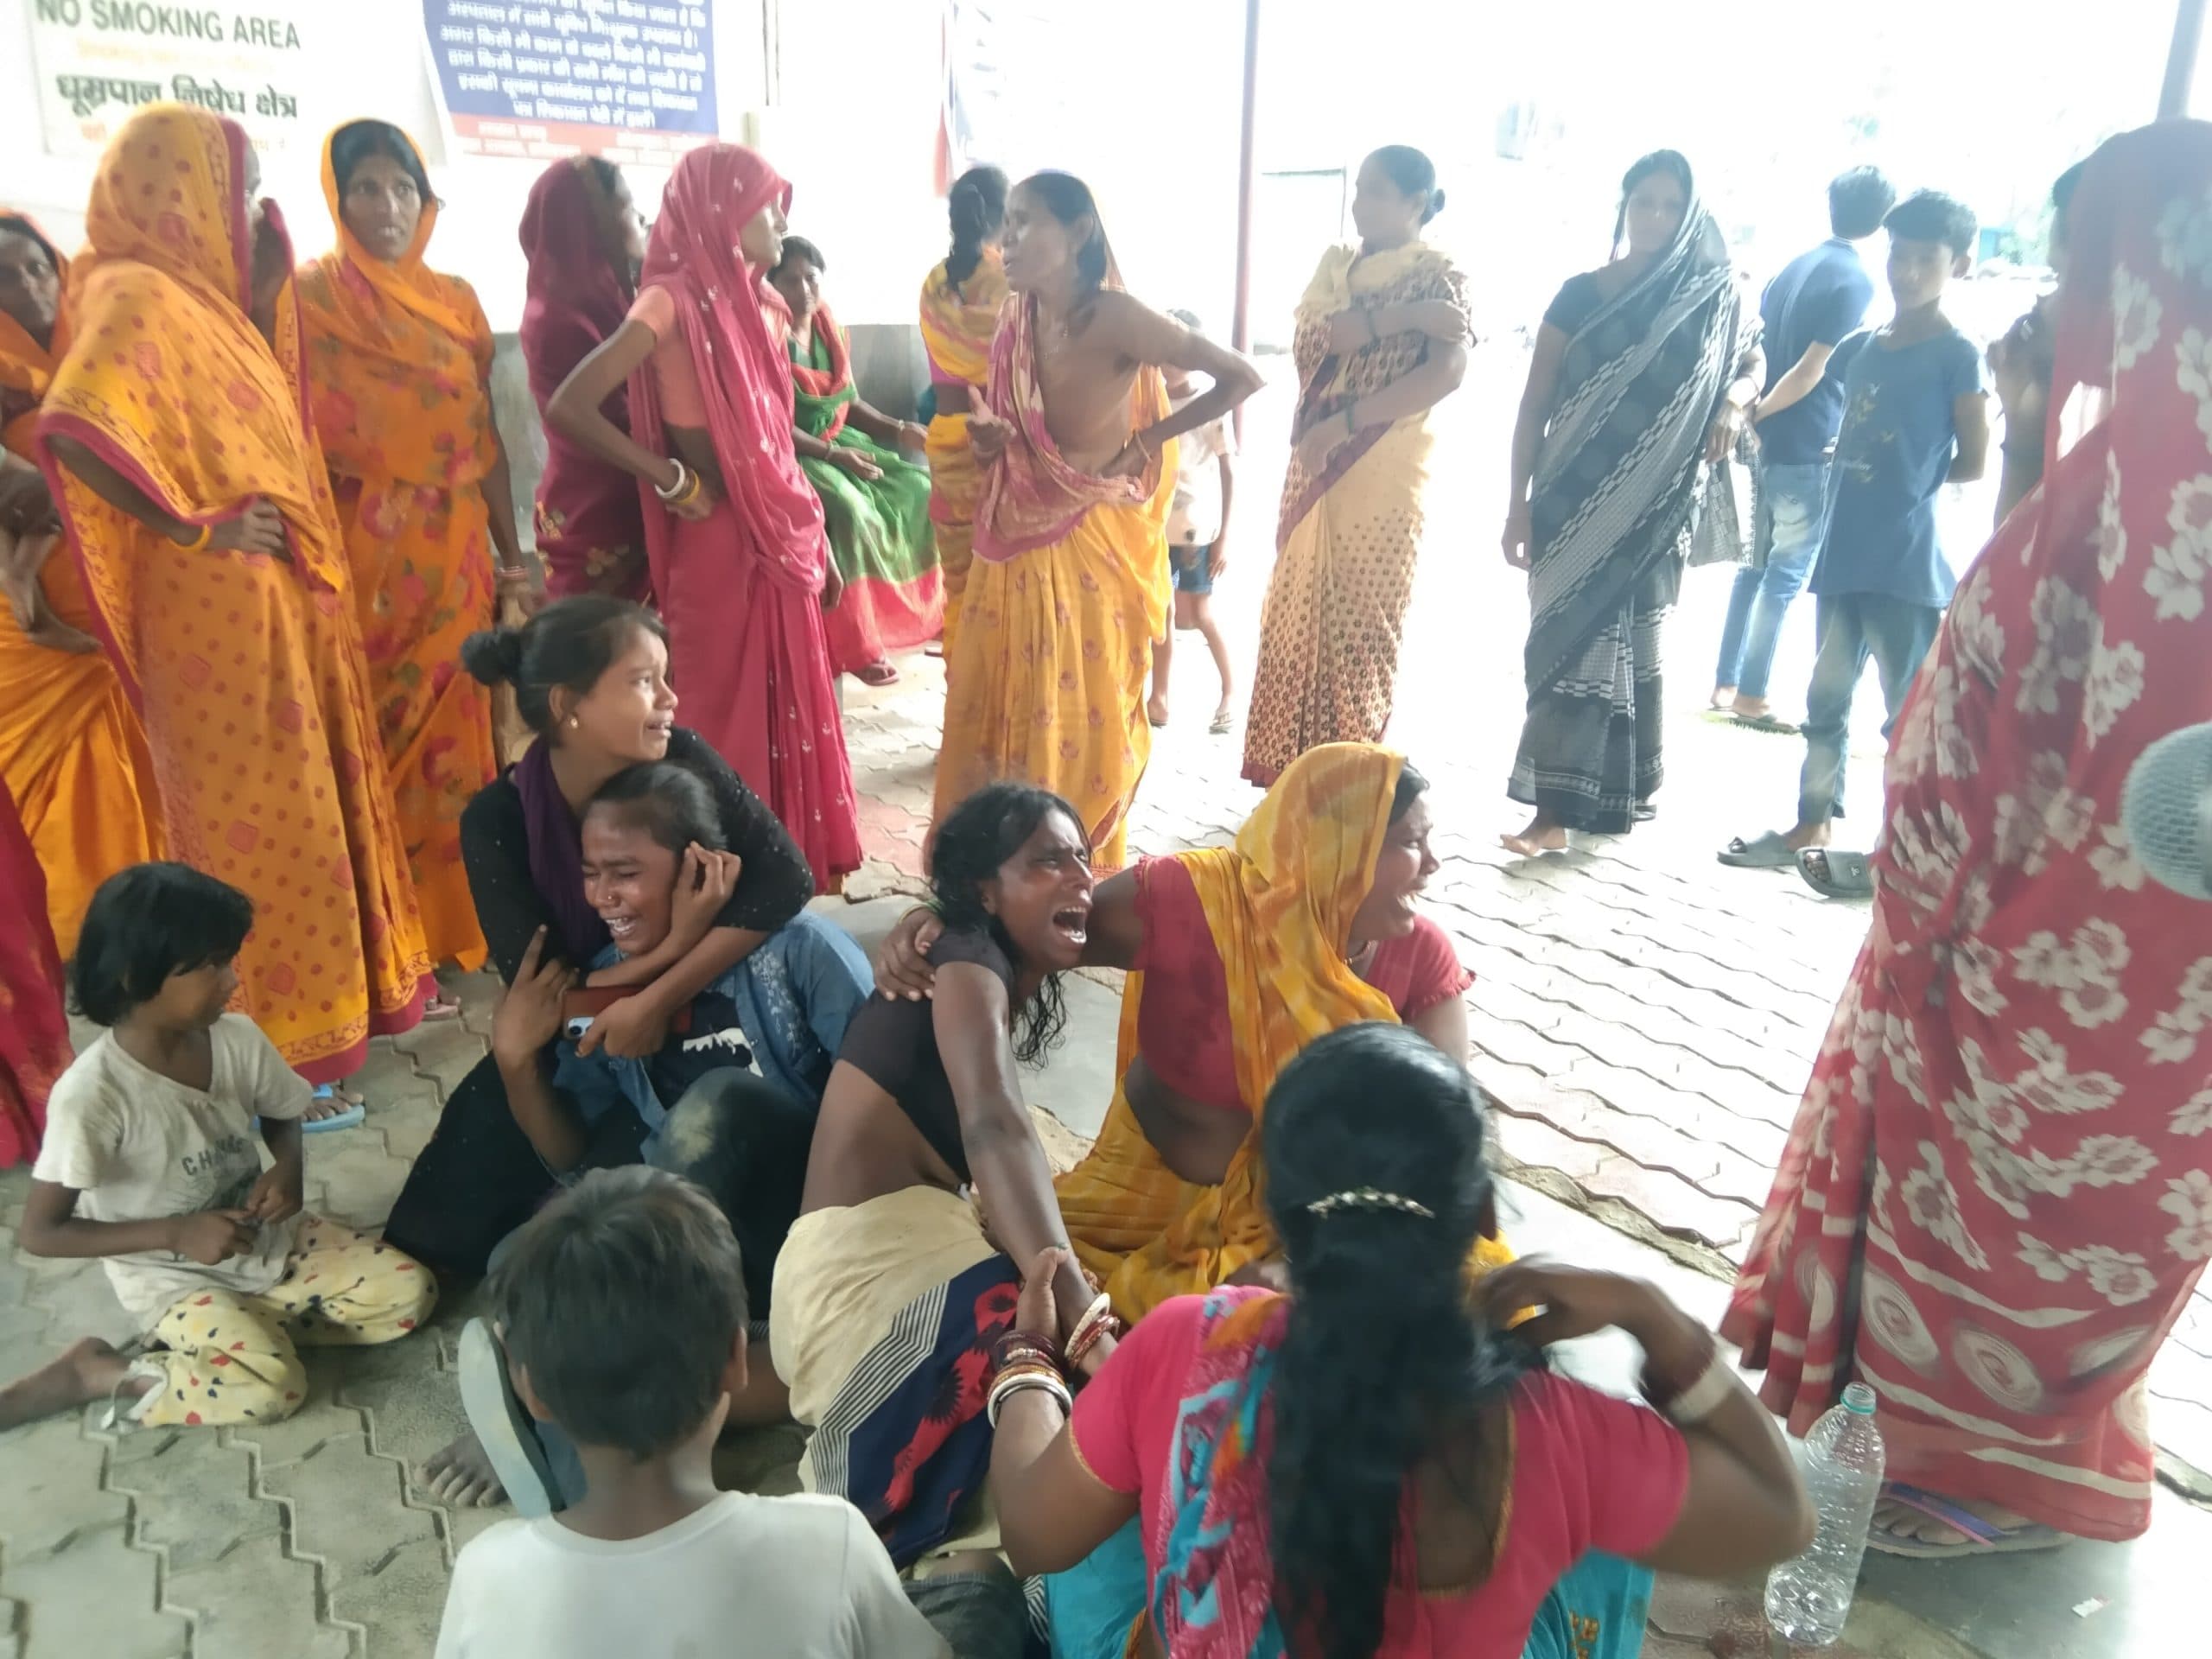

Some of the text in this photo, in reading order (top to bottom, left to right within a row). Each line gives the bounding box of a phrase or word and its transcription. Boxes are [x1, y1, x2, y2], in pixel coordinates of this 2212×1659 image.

[35, 0, 301, 49] NO SMOKING AREA
